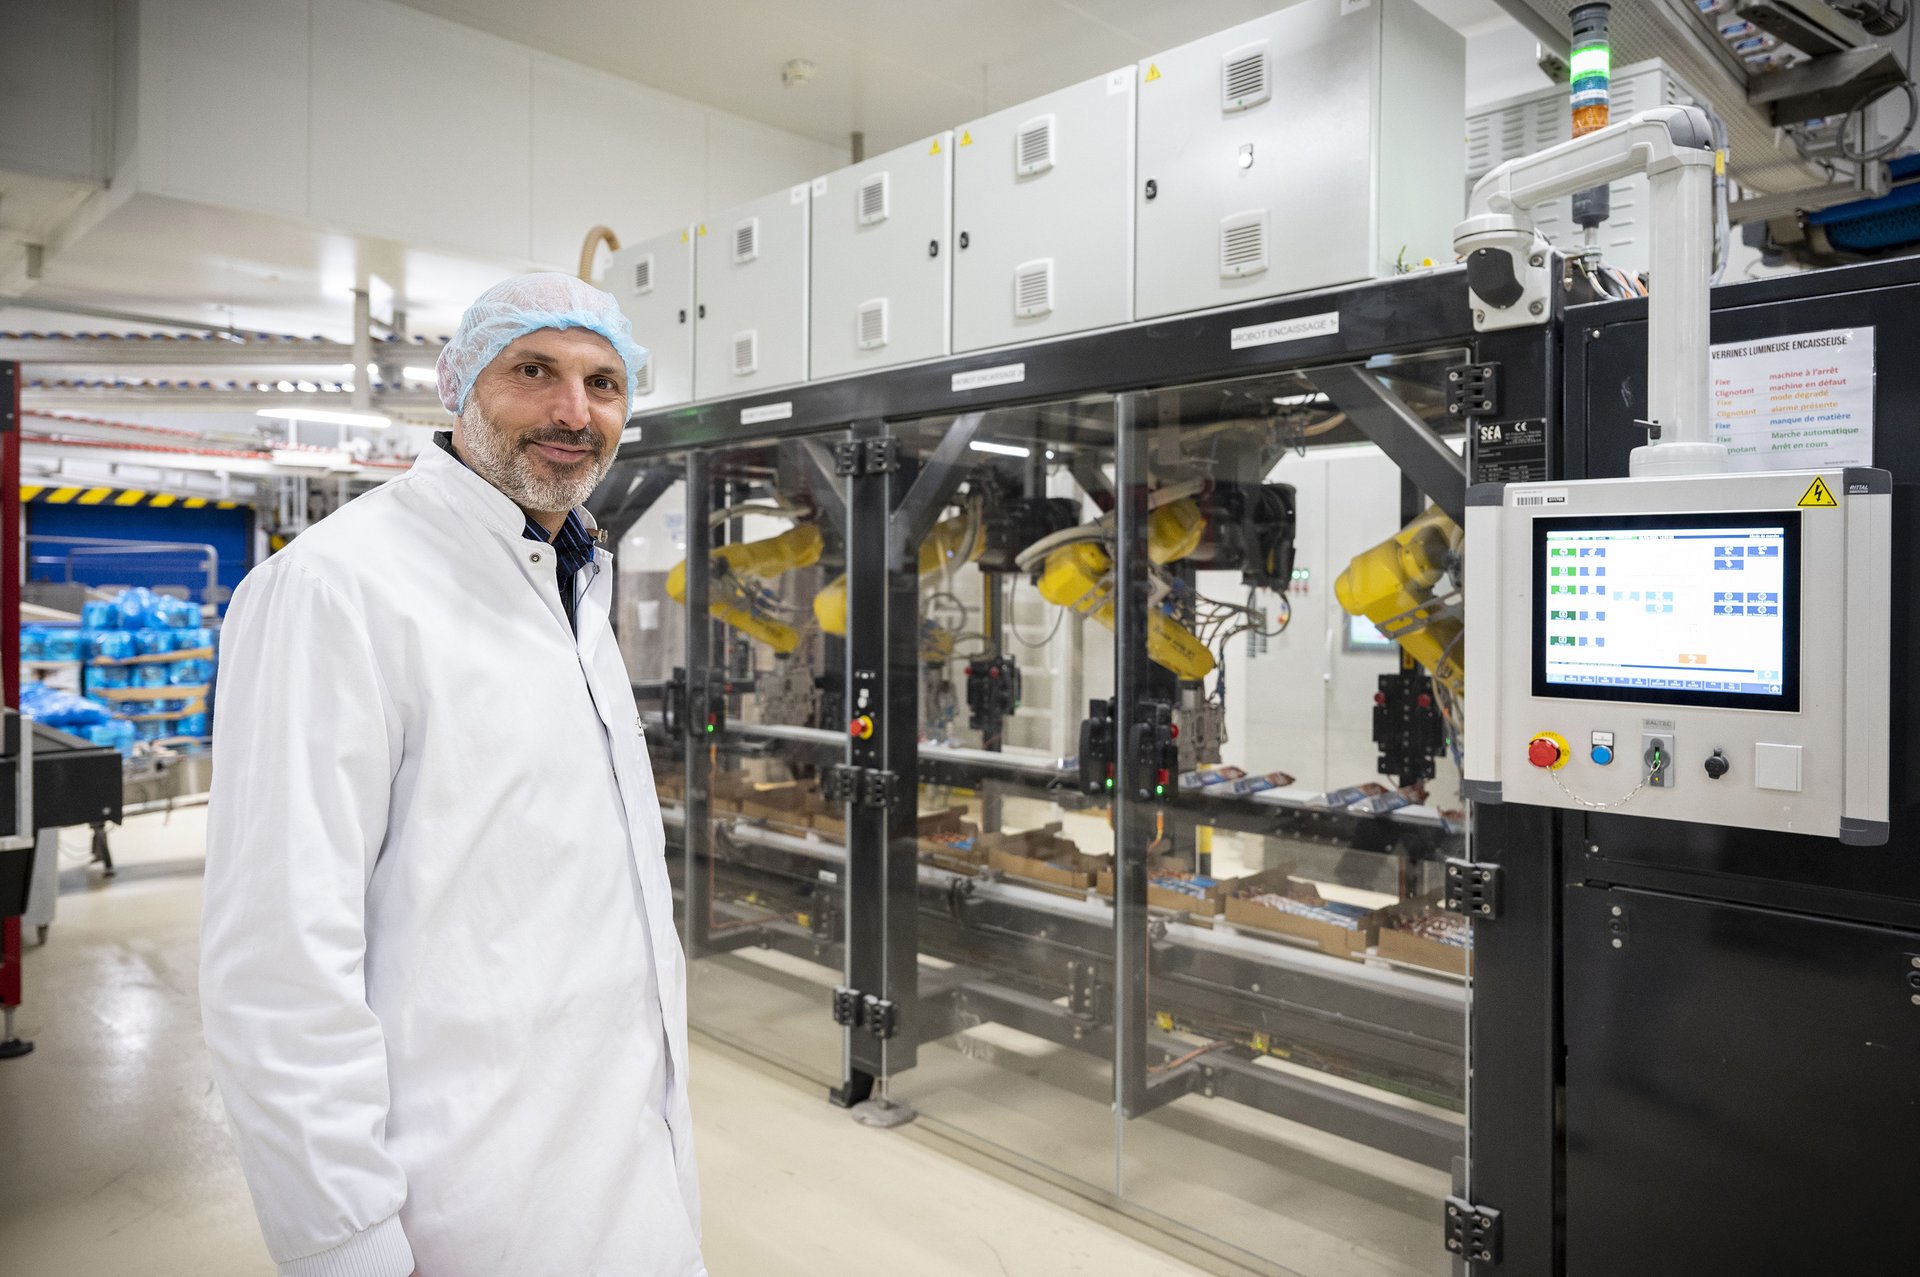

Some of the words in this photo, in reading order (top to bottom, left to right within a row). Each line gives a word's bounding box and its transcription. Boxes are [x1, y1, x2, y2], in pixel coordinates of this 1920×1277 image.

[1268, 321, 1326, 337] ENCAISSAGE
[1711, 347, 1748, 360] VERRINES
[1749, 341, 1791, 356] LUMINEUSE
[1792, 336, 1848, 350] ENCAISSEUSE
[1769, 371, 1804, 380] machine
[1812, 367, 1839, 376] l'arrêt
[1715, 387, 1755, 398] Clignotant
[1769, 382, 1804, 392] machine
[1818, 378, 1847, 387] défaut
[1770, 392, 1793, 401] mode
[1794, 389, 1829, 400] dégradé
[1716, 408, 1757, 418] Clignotant
[1771, 404, 1799, 413] alarme
[1800, 401, 1838, 411] présente
[1770, 417, 1803, 426] manque
[1817, 412, 1851, 421] matière
[1481, 425, 1502, 440] SEA
[1771, 430, 1801, 439] Marche
[1803, 426, 1859, 437] automatique
[1771, 442, 1791, 451] Arrêt
